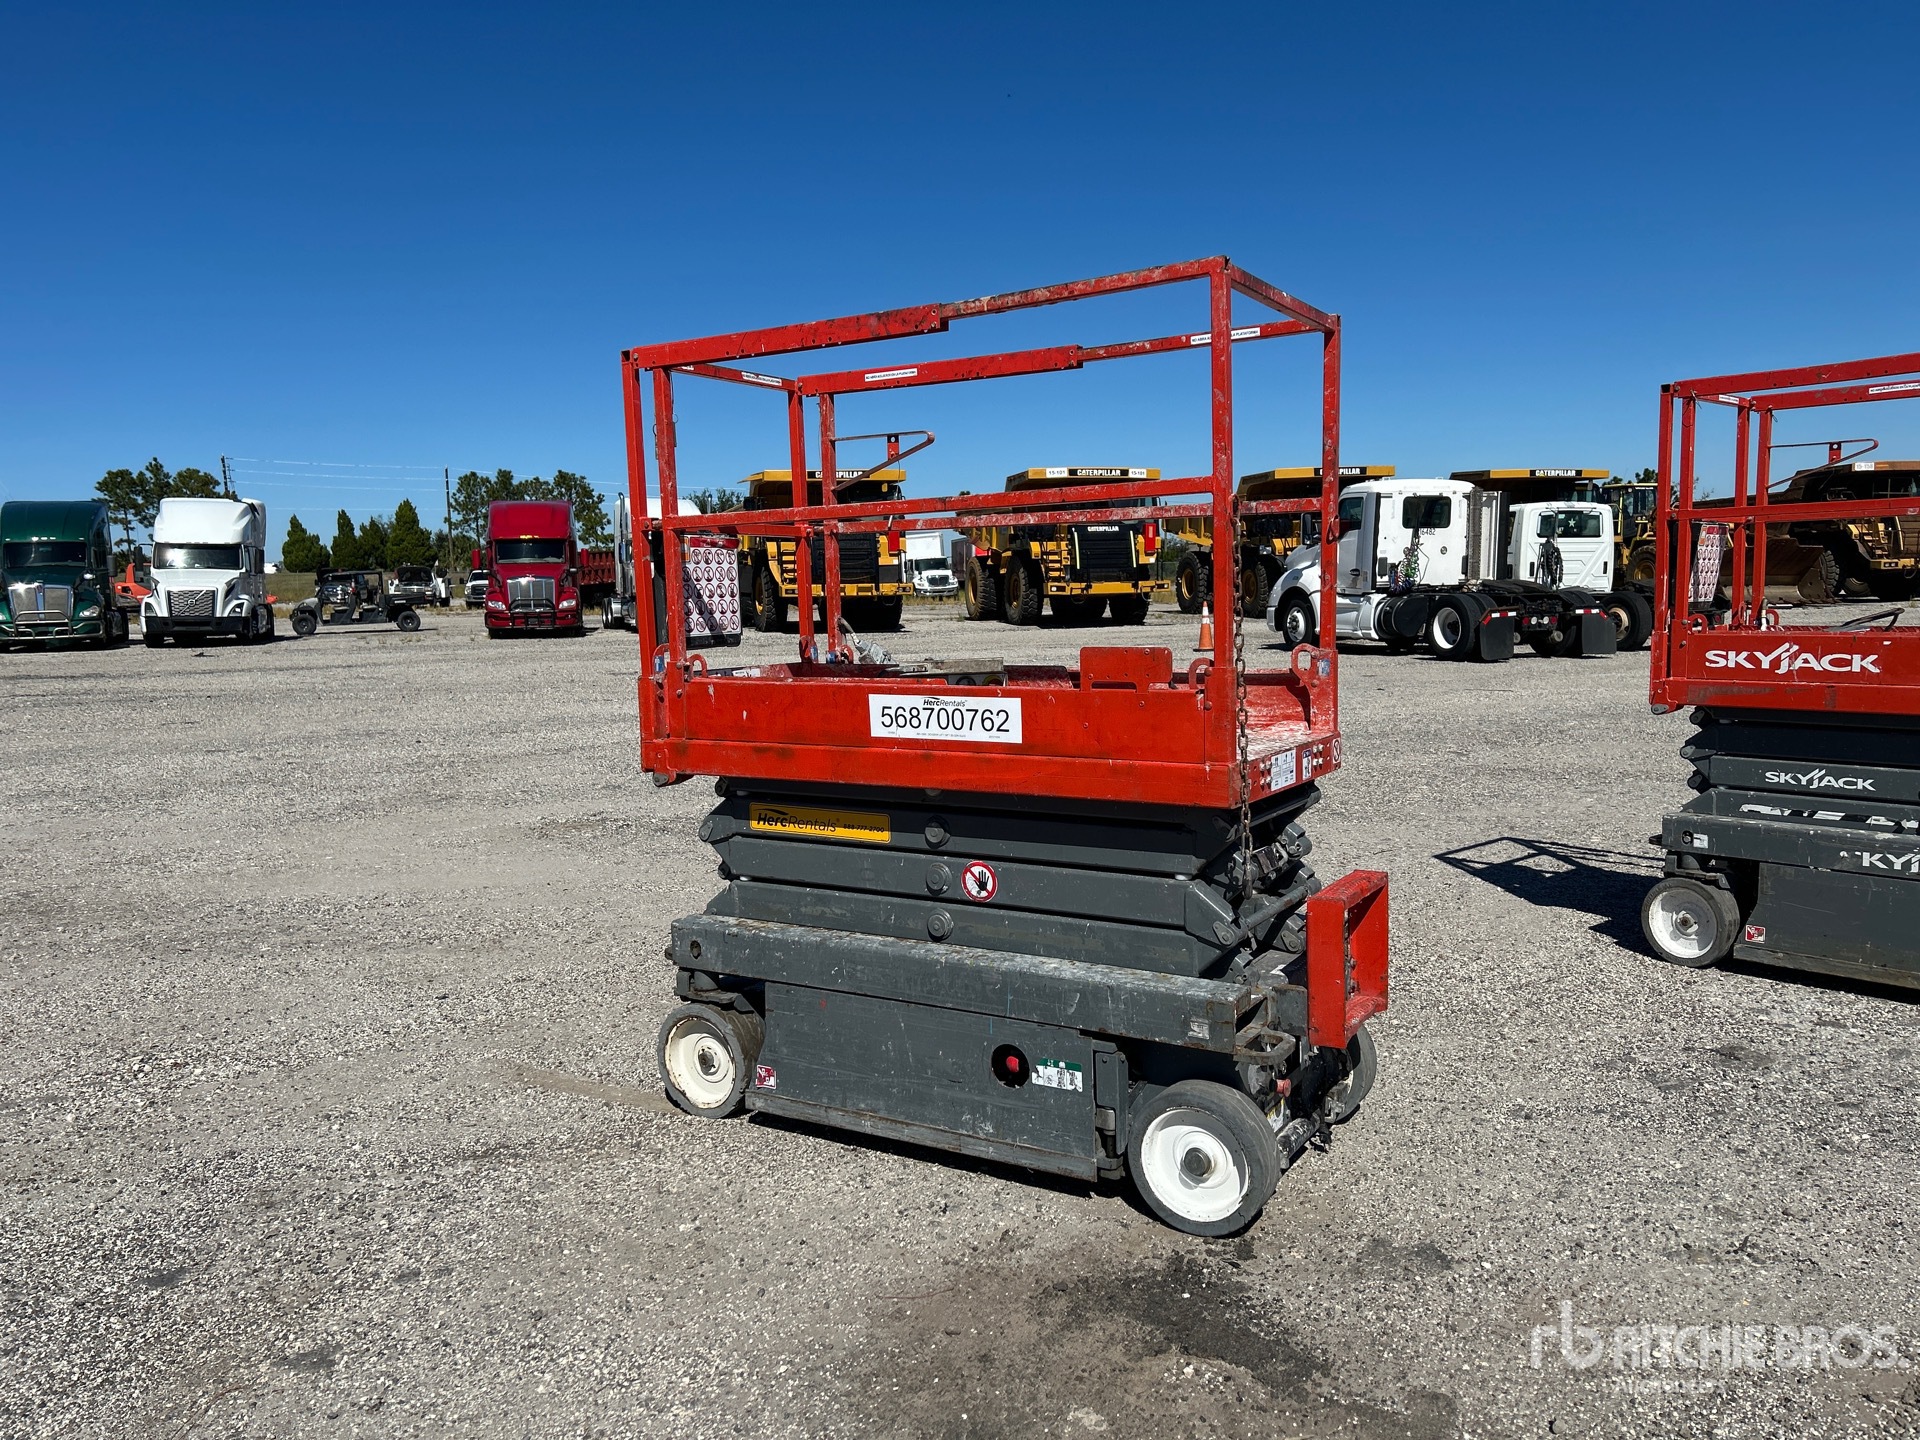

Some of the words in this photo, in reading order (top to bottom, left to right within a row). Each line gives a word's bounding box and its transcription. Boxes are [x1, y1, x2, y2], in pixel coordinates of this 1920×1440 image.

[815, 471, 863, 479] CRPILLA
[1319, 468, 1360, 476] PILLAR
[1535, 469, 1576, 477] CATERPILLAR
[1705, 642, 1881, 675] SKYJACK
[881, 705, 1010, 733] 568700762
[1764, 768, 1877, 791] SKYJACK
